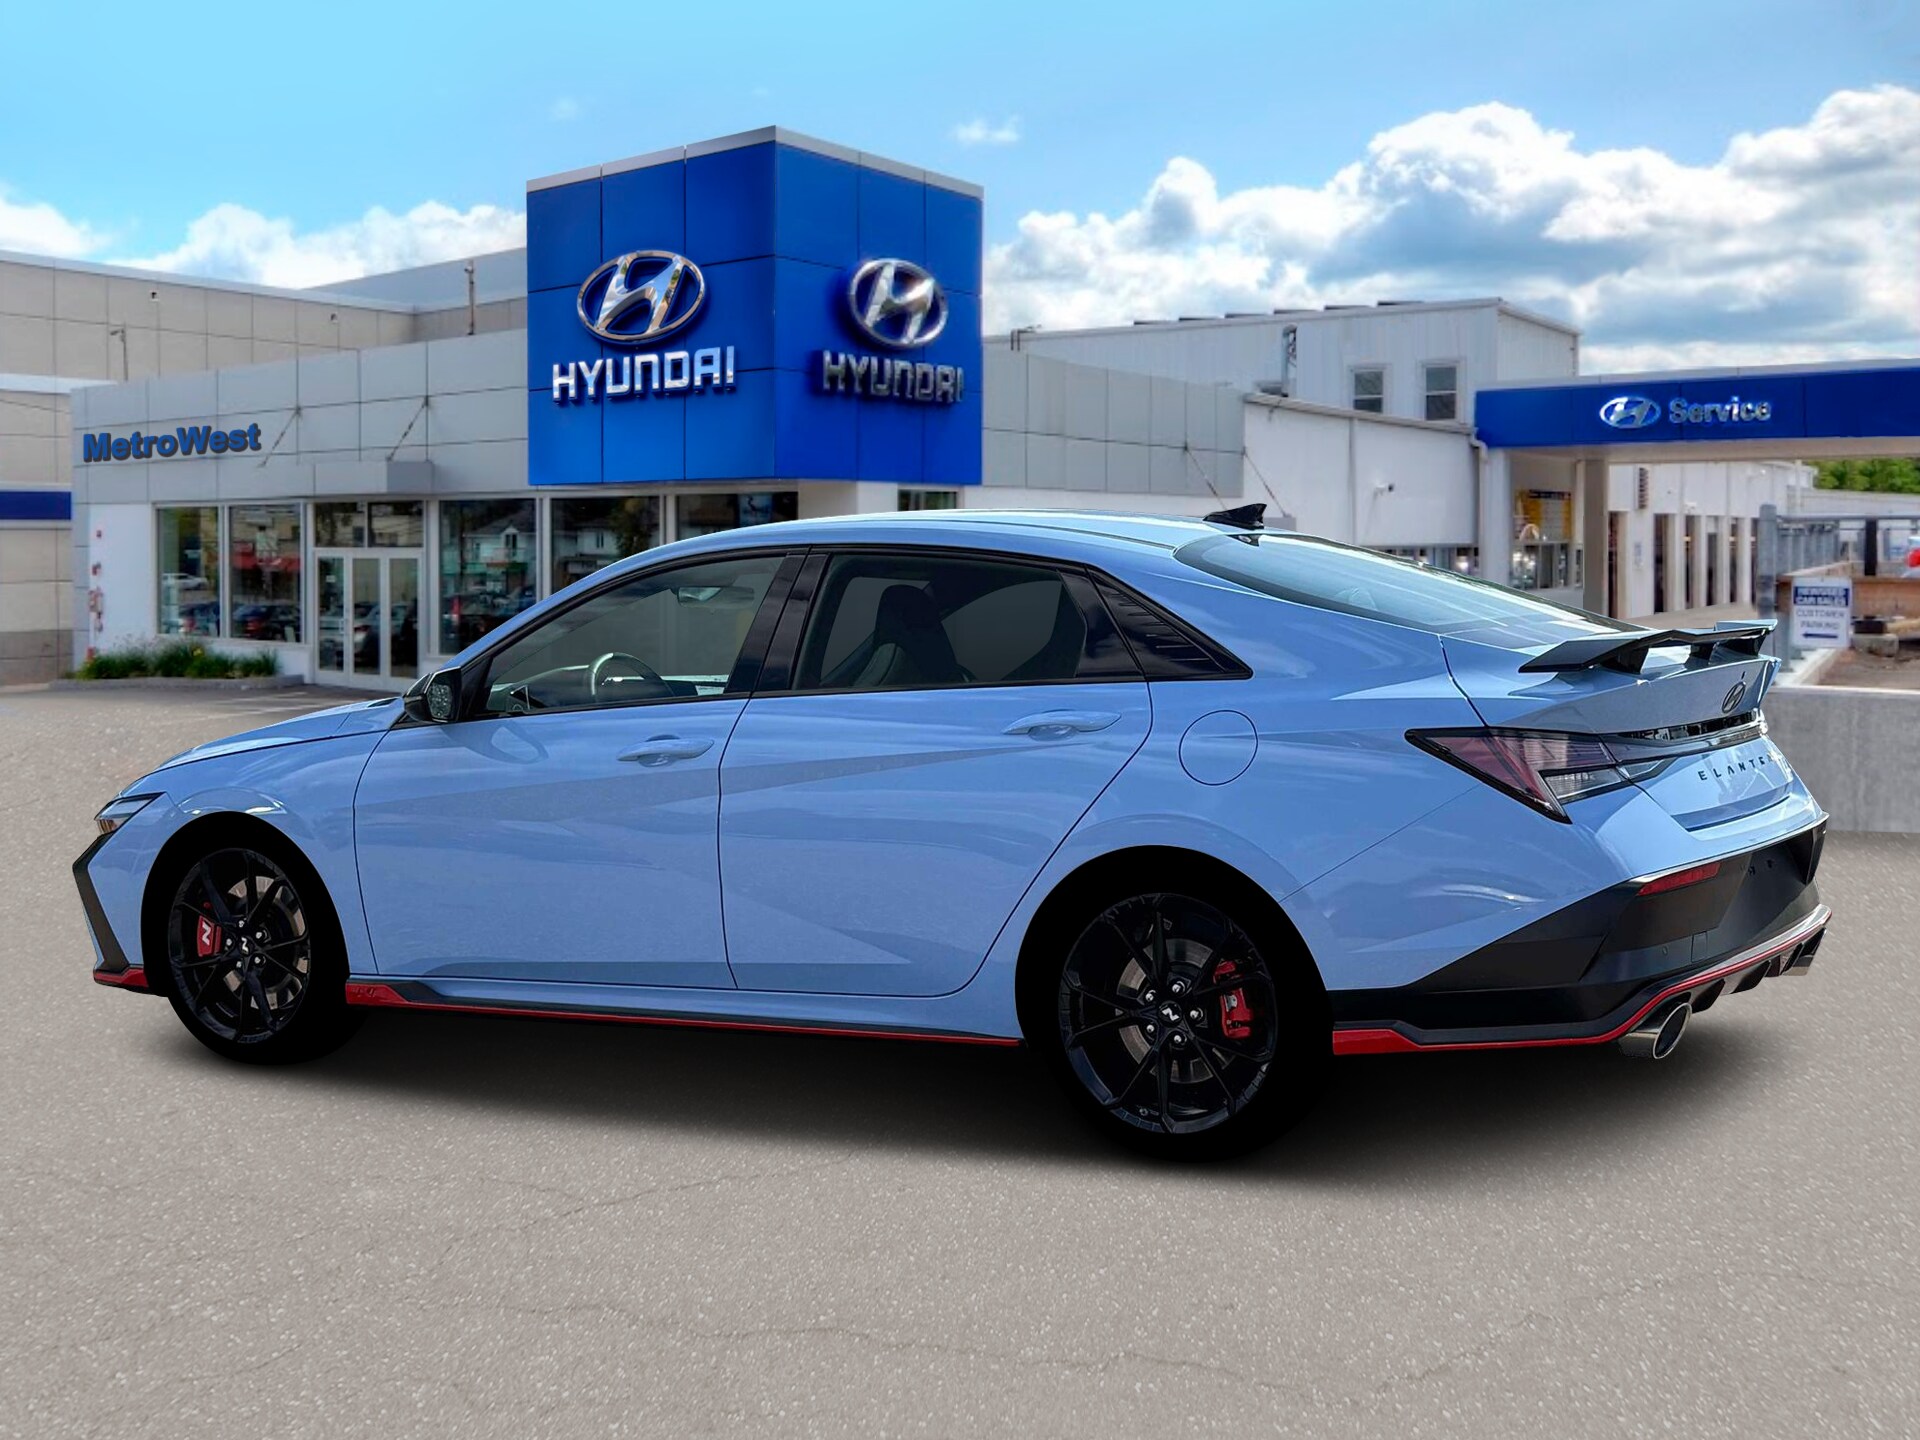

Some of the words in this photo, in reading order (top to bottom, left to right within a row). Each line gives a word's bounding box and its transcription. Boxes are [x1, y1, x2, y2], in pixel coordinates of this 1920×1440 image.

[552, 345, 736, 401] HYUNDAI
[821, 350, 965, 404] HYUNDAI
[1669, 396, 1771, 422] Service
[83, 422, 262, 463] MetroWest
[1796, 609, 1844, 618] CUSTOMER
[1800, 620, 1840, 630] PARKING
